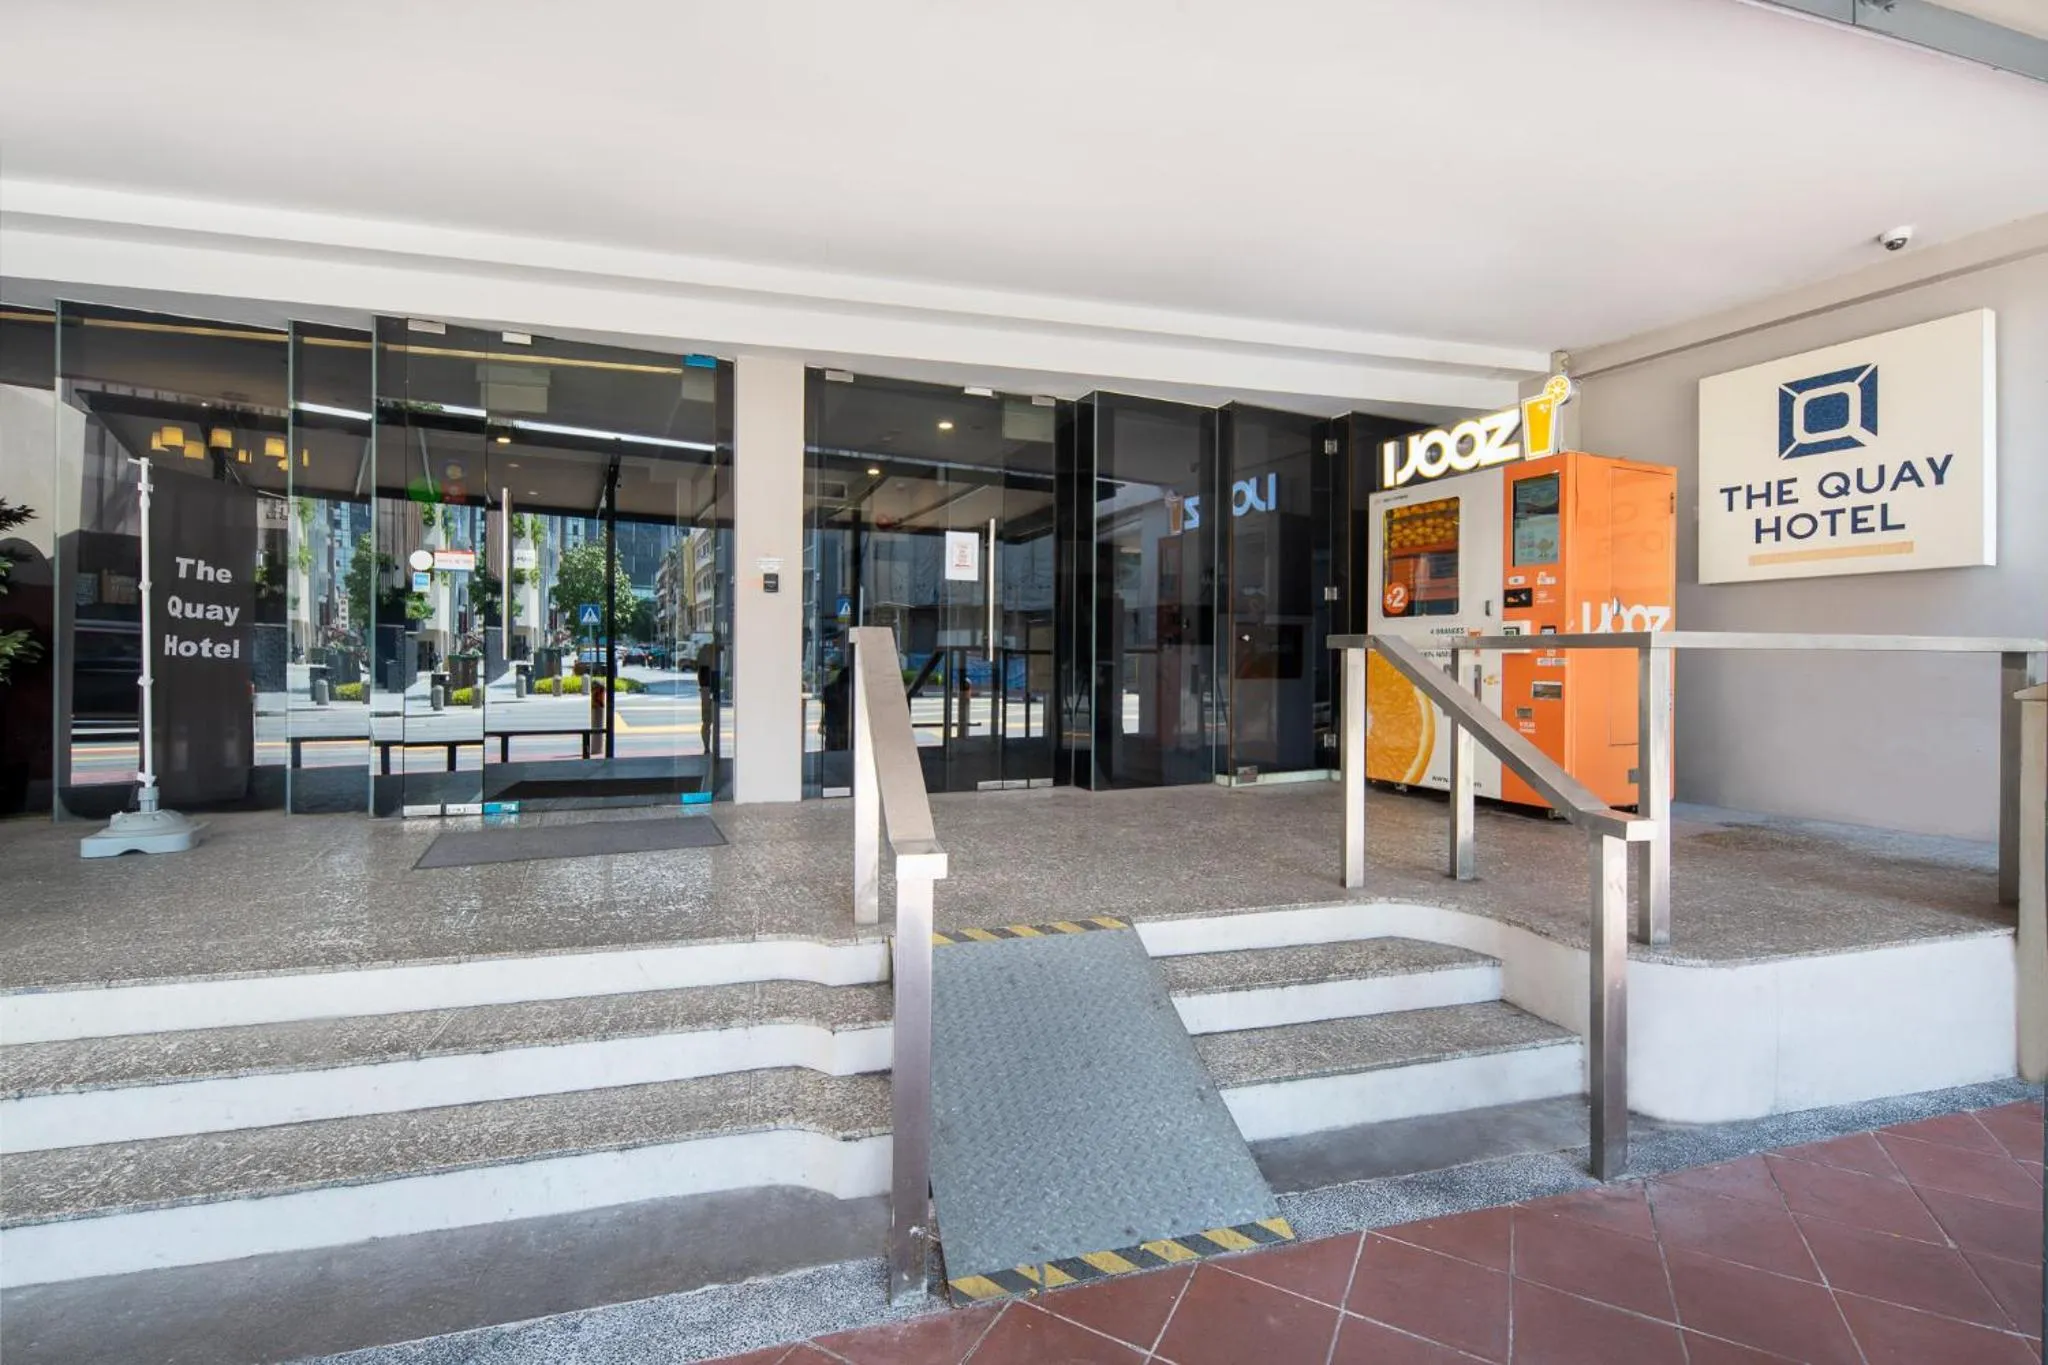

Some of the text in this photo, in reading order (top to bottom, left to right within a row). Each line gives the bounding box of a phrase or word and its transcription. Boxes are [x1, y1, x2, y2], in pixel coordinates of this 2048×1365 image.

[1382, 407, 1520, 488] IJOOZ
[1719, 454, 1953, 512] THE QUAY
[1754, 503, 1906, 544] HOTEL
[175, 556, 232, 583] The
[167, 595, 240, 627] Quay
[1386, 586, 1405, 607] $2
[164, 634, 240, 659] Hotel
